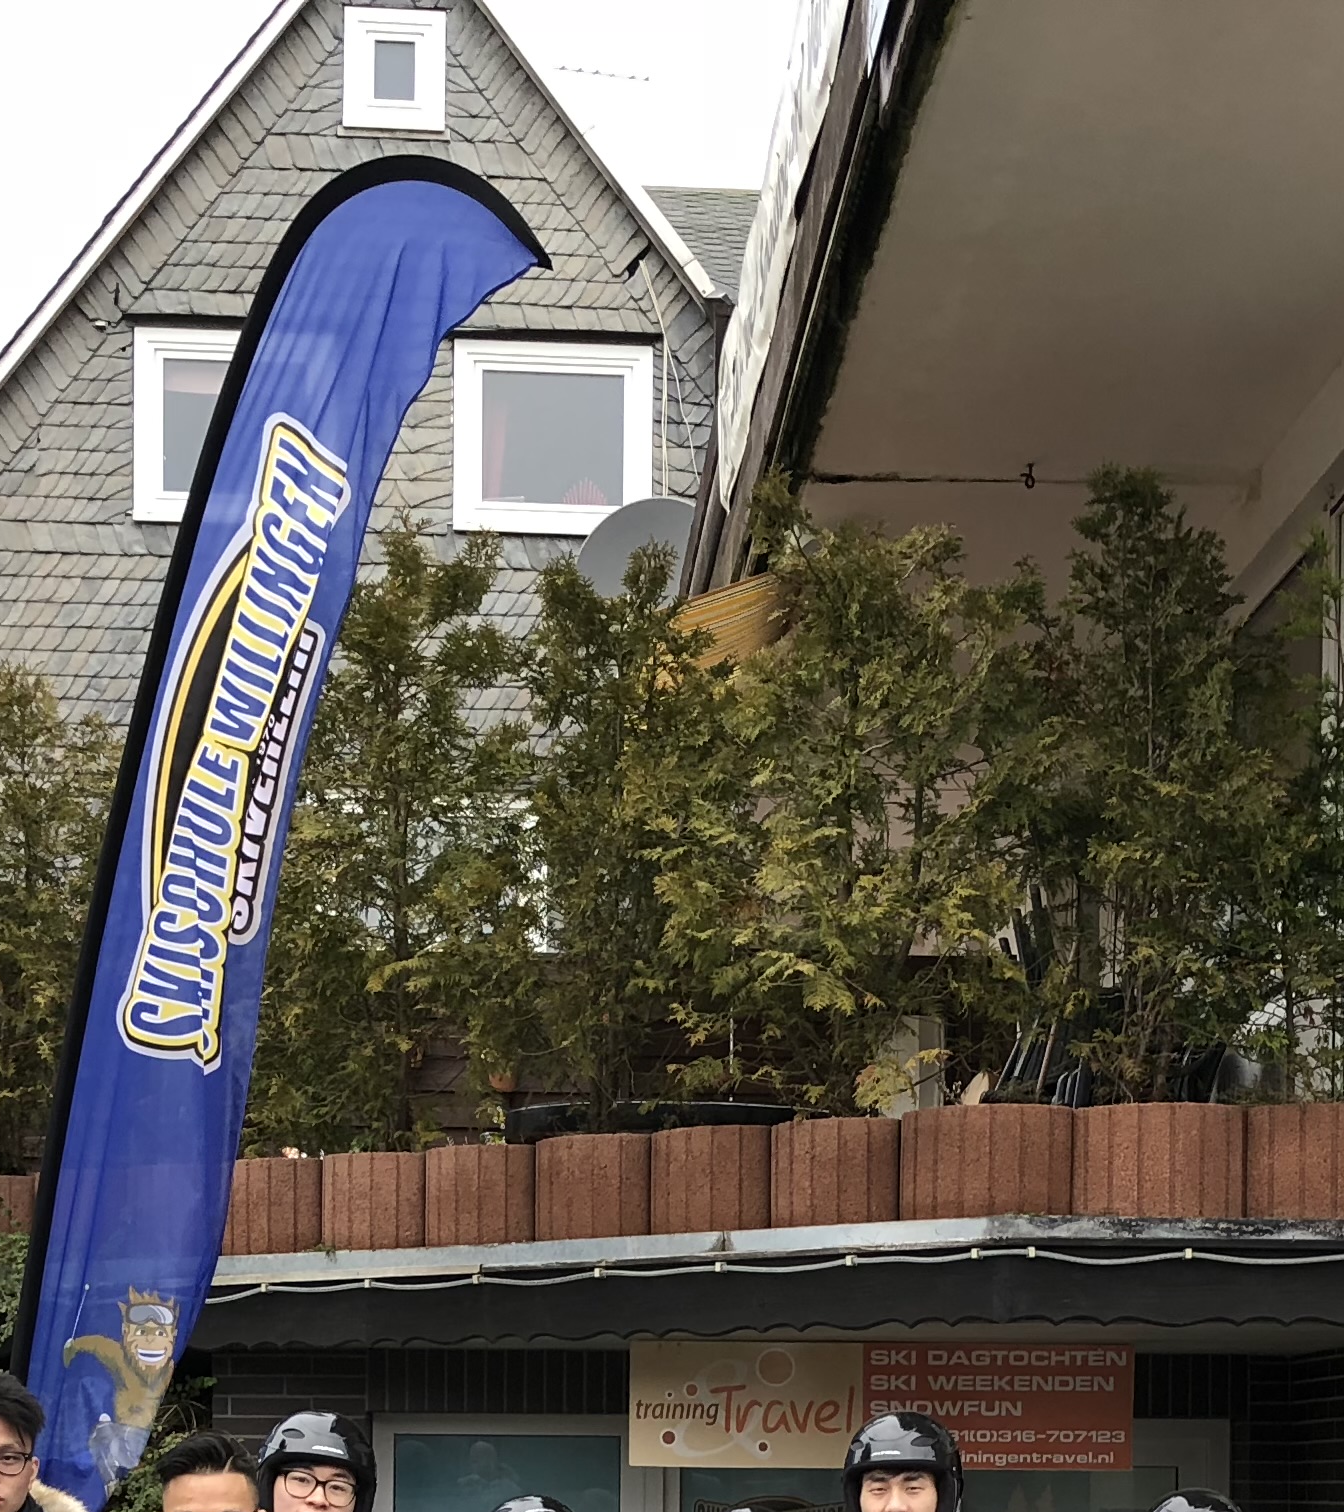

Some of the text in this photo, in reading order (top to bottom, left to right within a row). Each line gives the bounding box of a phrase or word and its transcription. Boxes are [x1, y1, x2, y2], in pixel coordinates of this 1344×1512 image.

[130, 439, 337, 1055] SKISCHULE WILLINGEN
[869, 1349, 1128, 1367] SKI DAGTOCHTEN
[869, 1375, 1115, 1392] SKI WEEKENDEN
[635, 1391, 720, 1426] training
[710, 1384, 856, 1435] Travel
[869, 1400, 1023, 1417] SNOWFUN
[961, 1451, 1115, 1465] iningentravel.nl
